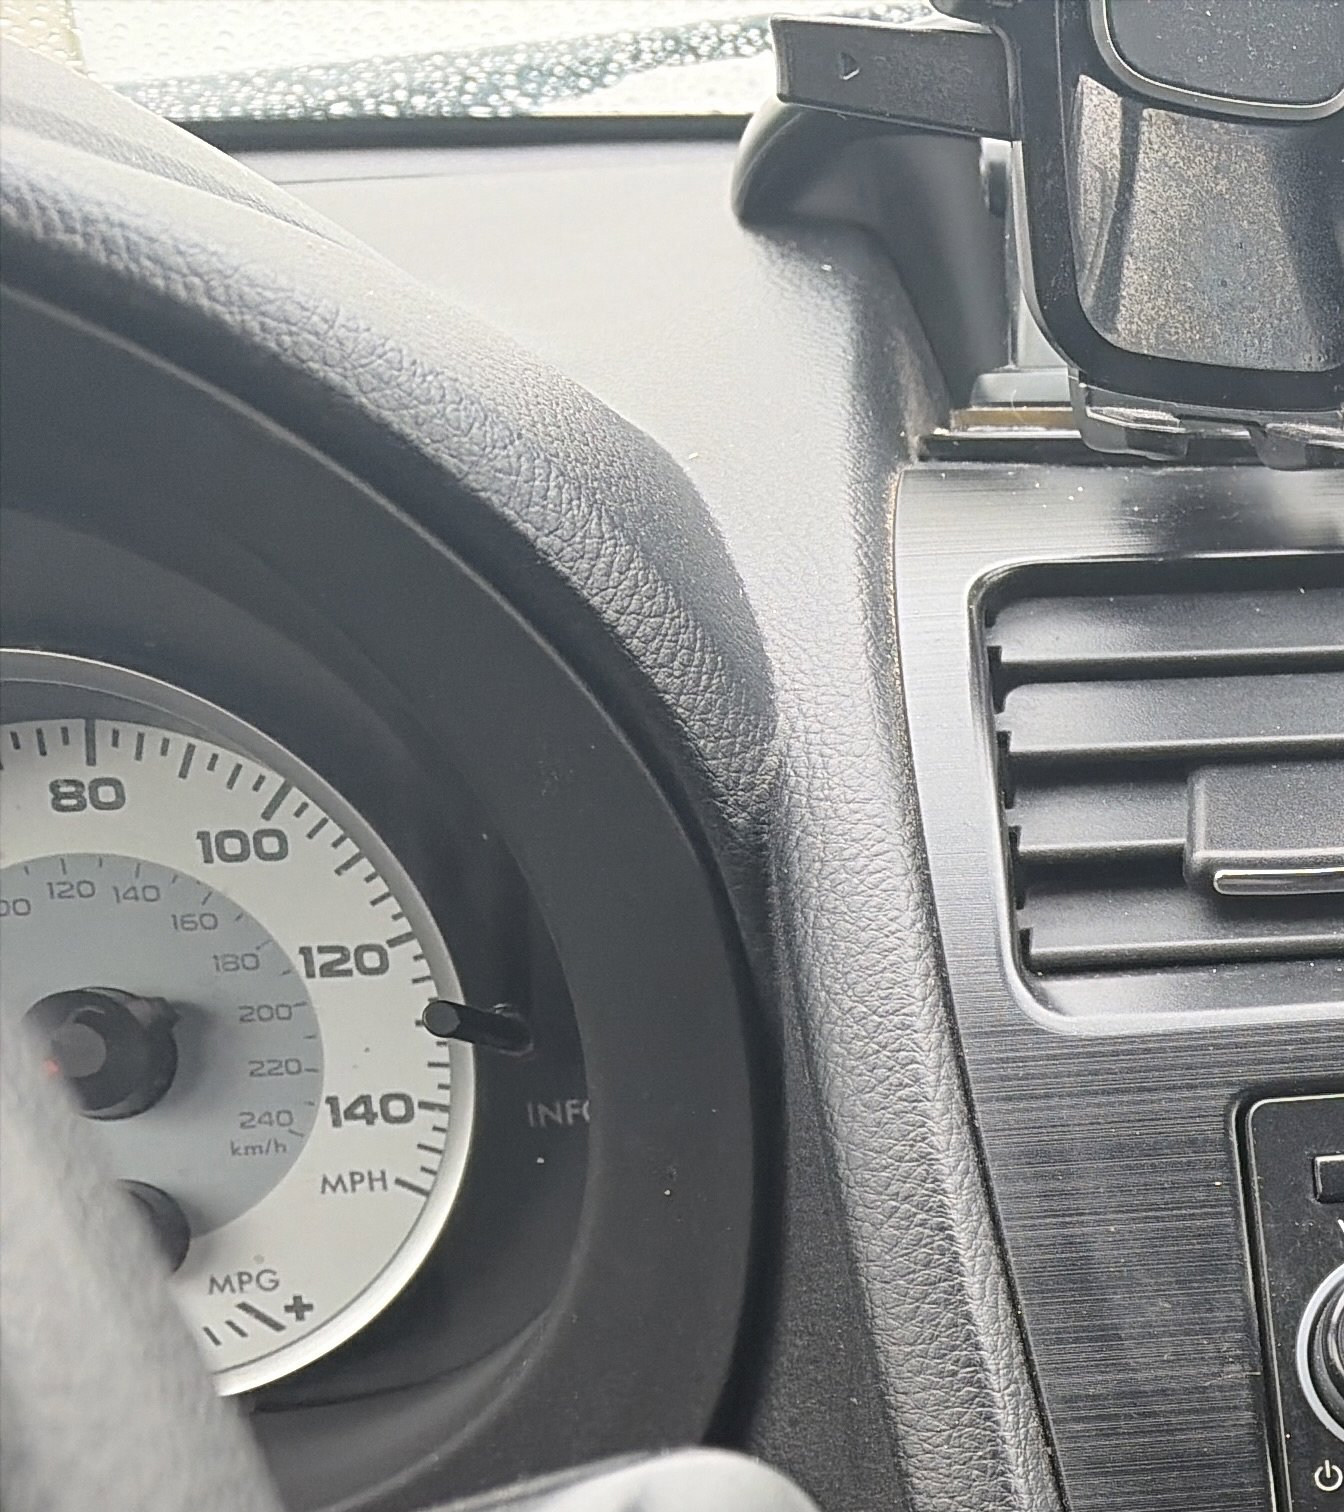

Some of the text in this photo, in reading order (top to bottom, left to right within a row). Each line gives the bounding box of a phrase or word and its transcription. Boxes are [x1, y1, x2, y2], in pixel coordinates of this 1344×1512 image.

[48, 777, 126, 813] 80
[195, 828, 289, 864] 100
[46, 879, 96, 900] 120
[112, 884, 161, 904] 140
[170, 912, 219, 932] 160
[212, 952, 261, 972] 180
[299, 943, 390, 979] 120
[237, 1003, 293, 1025] 200
[247, 1058, 303, 1078] 220
[239, 1109, 294, 1130] 240
[325, 1091, 416, 1129] 140
[230, 1138, 287, 1156] km/h
[320, 1169, 388, 1195] MPH
[207, 1268, 280, 1296] MPG
